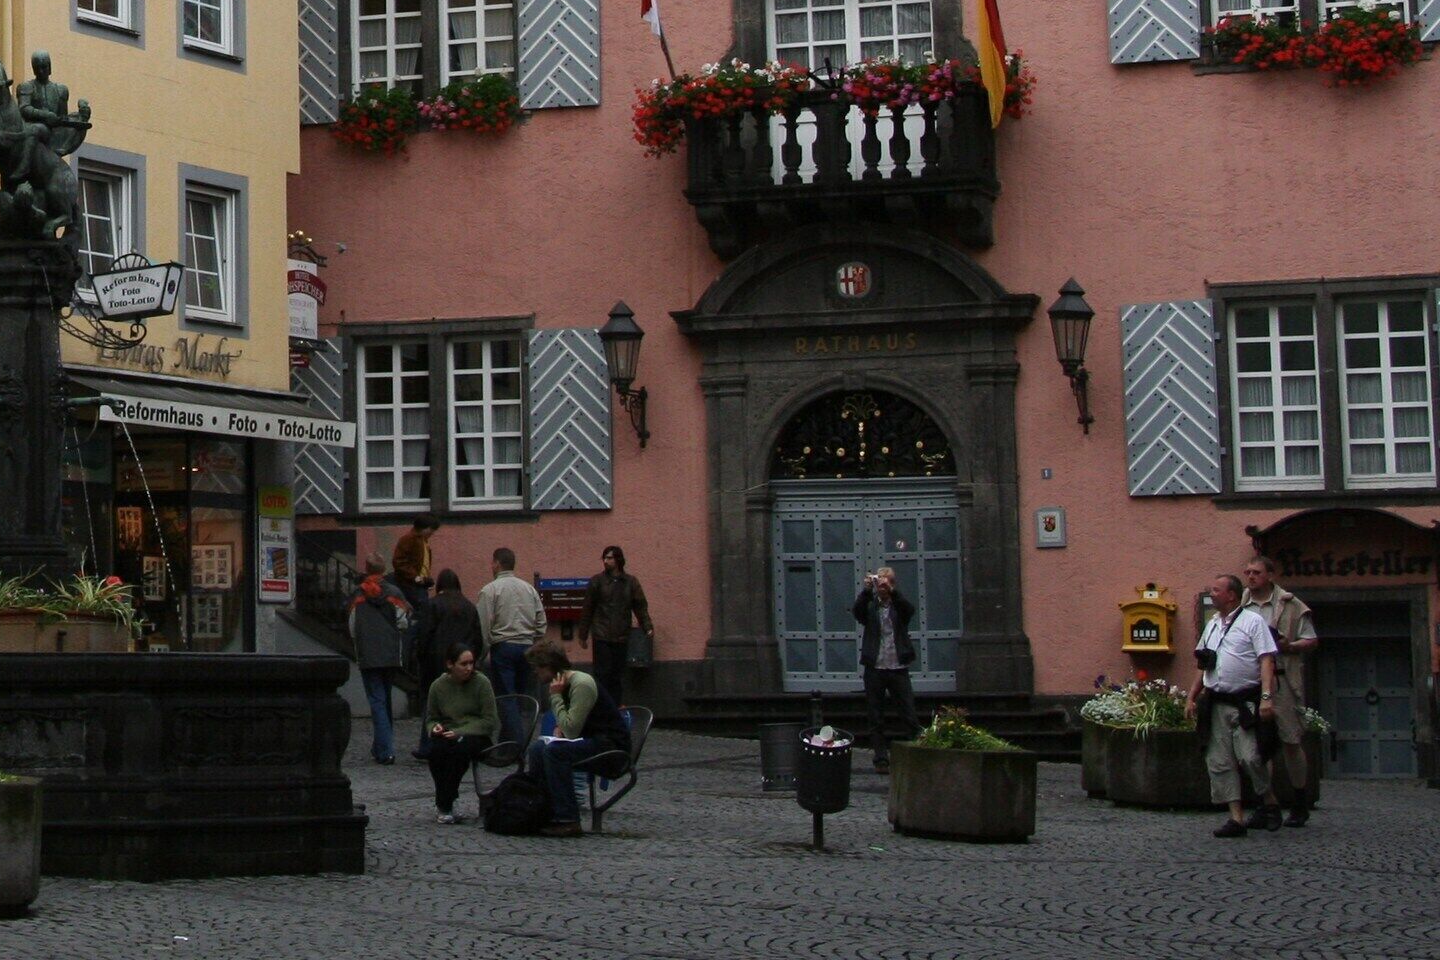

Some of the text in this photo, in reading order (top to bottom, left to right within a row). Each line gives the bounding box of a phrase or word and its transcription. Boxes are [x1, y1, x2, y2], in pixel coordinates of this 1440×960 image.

[102, 274, 161, 295] Reformhaus
[122, 287, 141, 297] Foto
[108, 296, 156, 309] Toto-Lotto
[794, 331, 920, 355] RATHAUS
[173, 333, 243, 379] Markt
[118, 400, 342, 442] Reformhaus Foto Toto-Lotto
